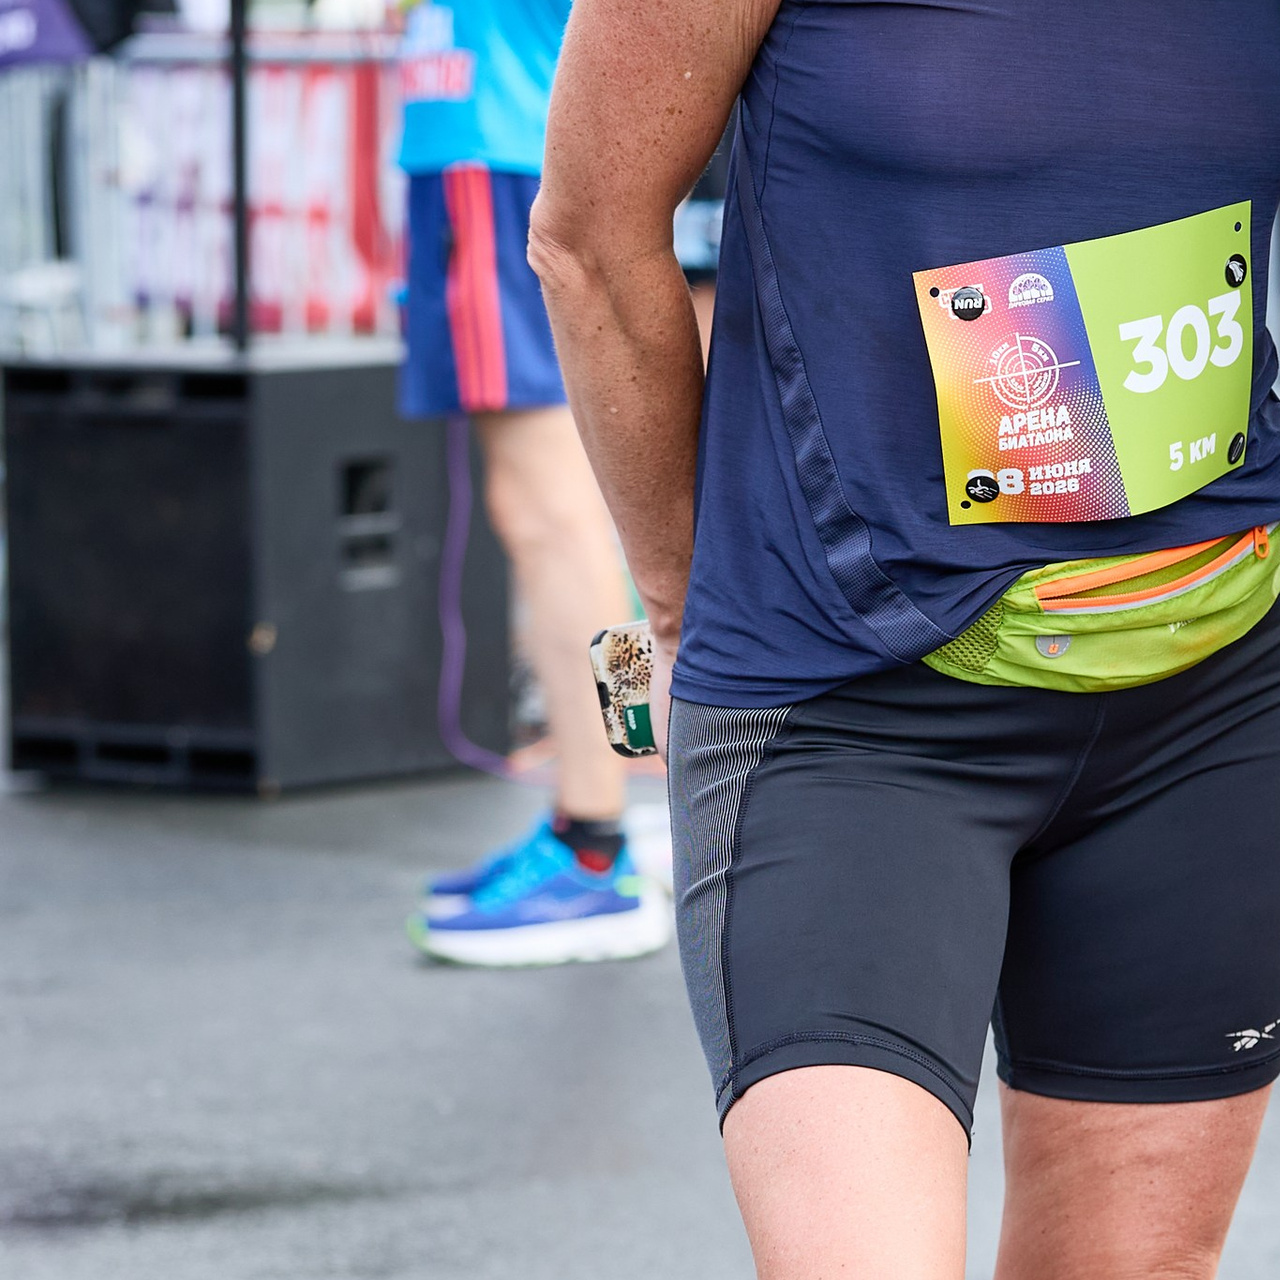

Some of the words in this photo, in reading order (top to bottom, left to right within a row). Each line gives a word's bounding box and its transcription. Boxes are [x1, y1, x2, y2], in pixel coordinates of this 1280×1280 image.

[954, 297, 983, 310] RUN
[1118, 289, 1244, 394] 303
[998, 405, 1071, 436] АРЕНА
[998, 426, 1074, 451] БИАТЛОНА
[1169, 441, 1184, 472] 5
[1189, 432, 1217, 465] КМ
[1028, 458, 1093, 480] ИЮНЯ
[1029, 479, 1080, 496] 2026
